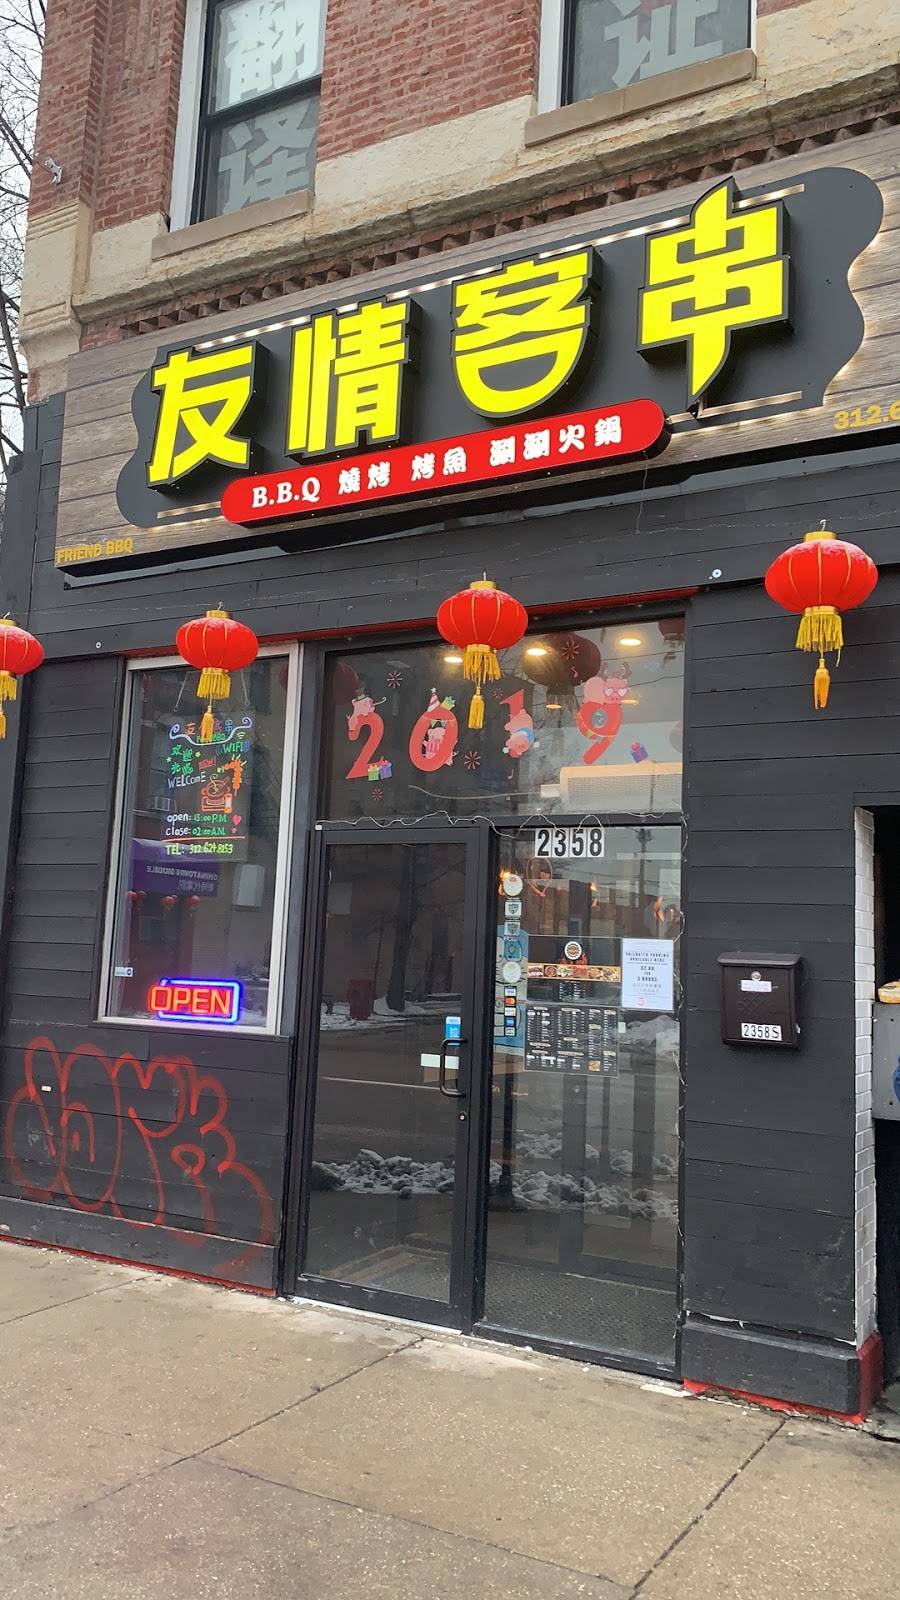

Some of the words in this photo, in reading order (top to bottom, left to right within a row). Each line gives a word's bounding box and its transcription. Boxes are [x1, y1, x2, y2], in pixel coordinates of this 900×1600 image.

[148, 184, 785, 482] 友情客串
[252, 477, 321, 508] B.B.Q
[338, 461, 391, 495] 燒烤
[411, 446, 467, 481] 烤魚
[56, 543, 102, 563] FRIEND
[106, 537, 133, 555] BBQ
[223, 741, 244, 754] WIFI
[167, 813, 191, 825] open:
[165, 827, 191, 836] close:
[165, 843, 185, 855] TEL:
[537, 828, 602, 857] 2358
[150, 985, 232, 1015] OPEN
[743, 1024, 779, 1039] 2358S
